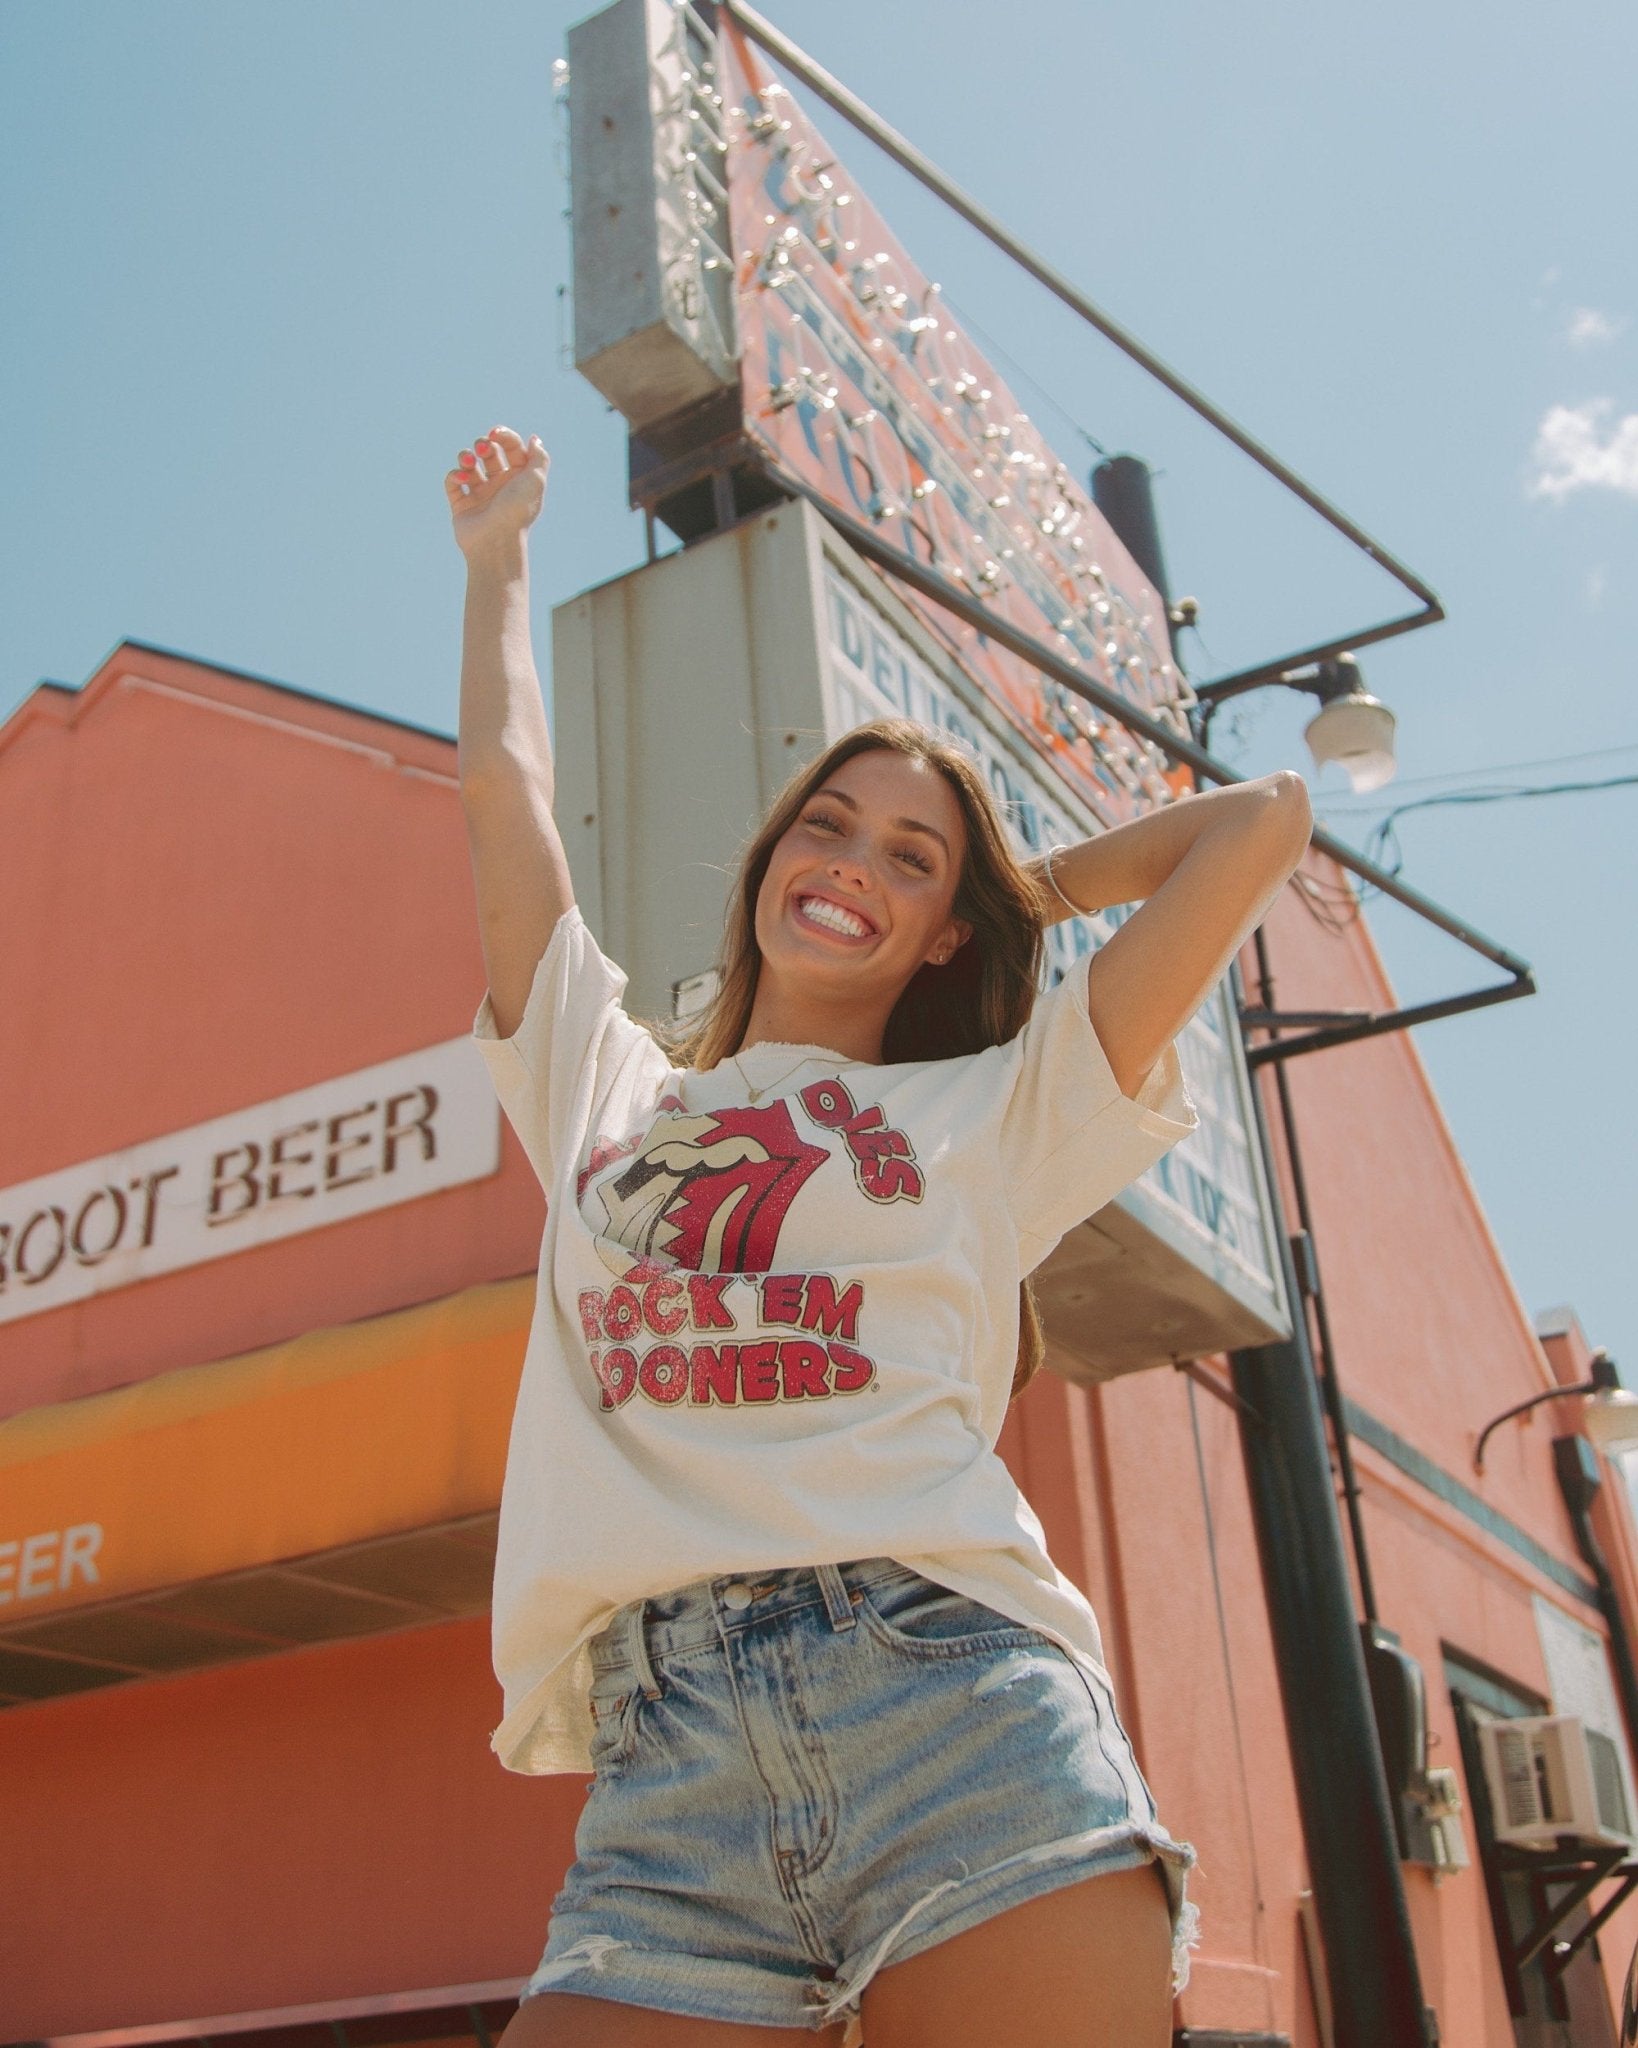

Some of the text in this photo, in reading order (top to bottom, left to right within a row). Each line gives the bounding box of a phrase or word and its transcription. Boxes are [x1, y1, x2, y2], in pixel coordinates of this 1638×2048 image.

[0, 1166, 180, 1294] OOT
[206, 1084, 440, 1228] BEER
[589, 1340, 877, 1410] OONERS
